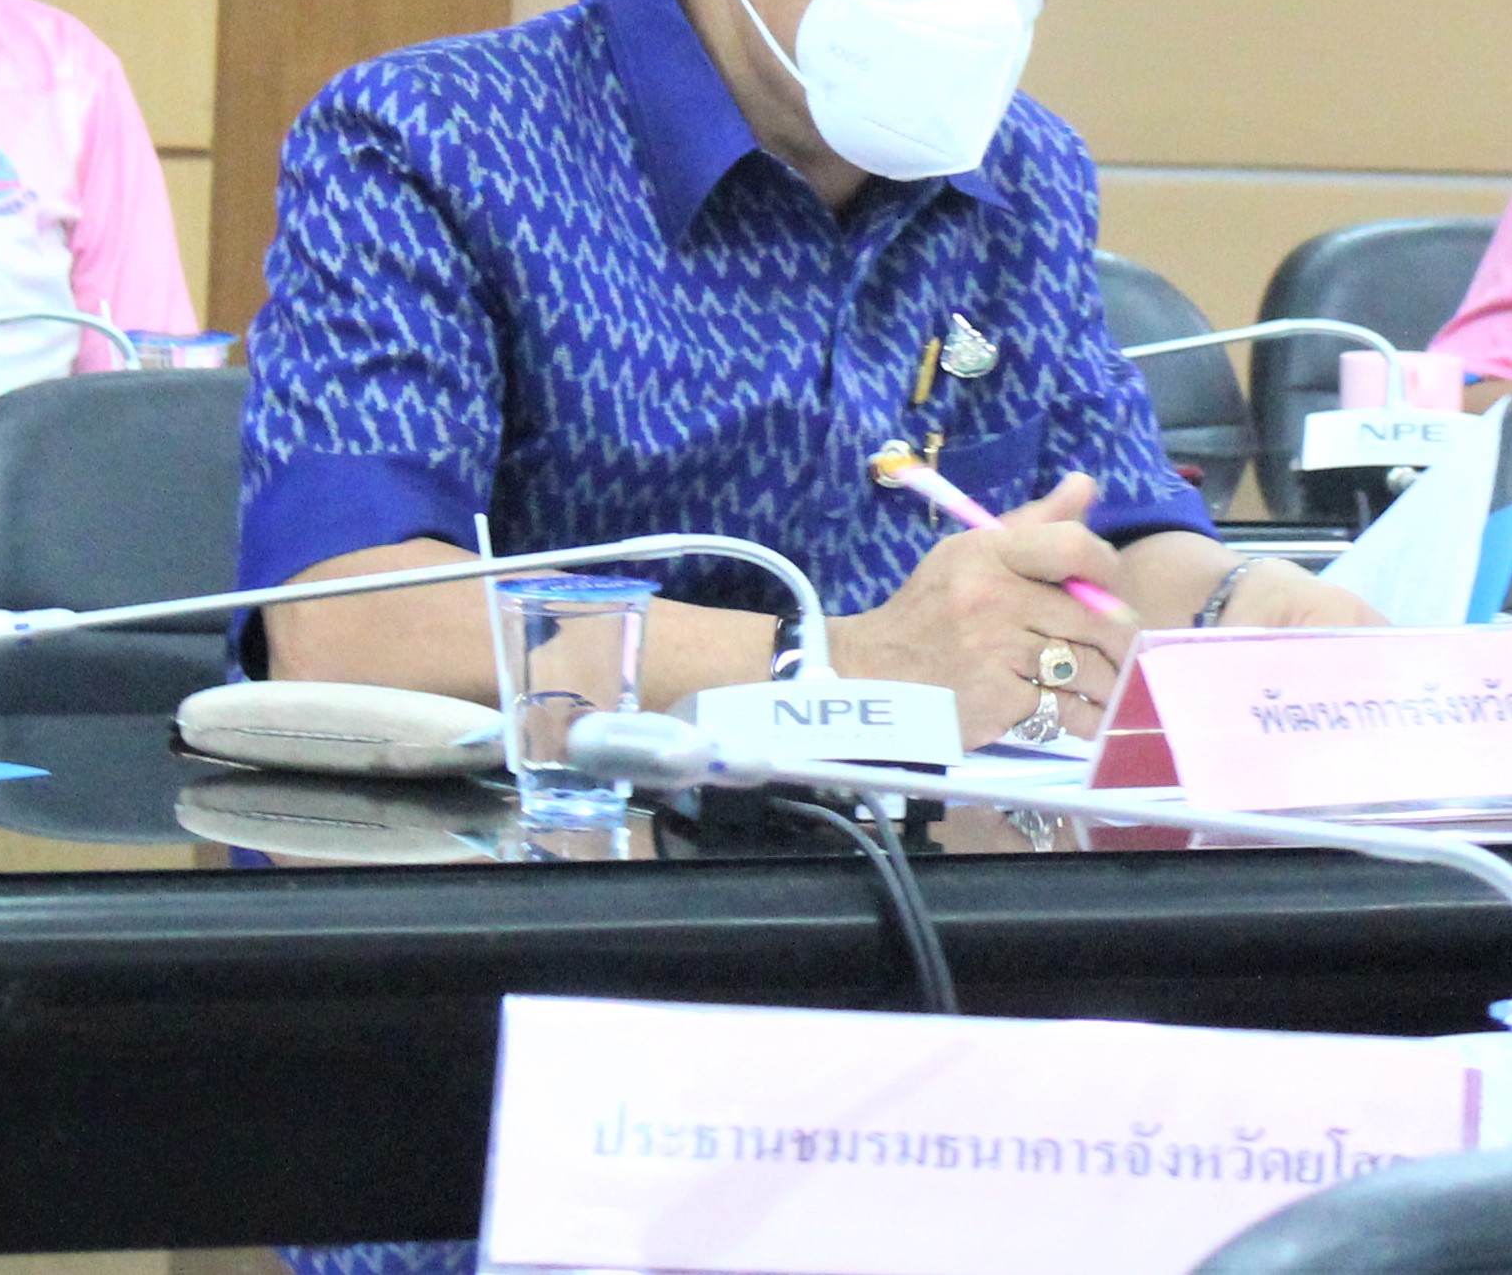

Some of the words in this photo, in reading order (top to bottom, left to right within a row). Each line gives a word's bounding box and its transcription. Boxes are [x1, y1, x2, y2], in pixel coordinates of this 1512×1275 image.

[1361, 423, 1447, 442] NPE
[774, 699, 894, 726] NPE
[592, 1102, 1417, 1185] ประธานชมรมธนาคารจังหวัดยโส
